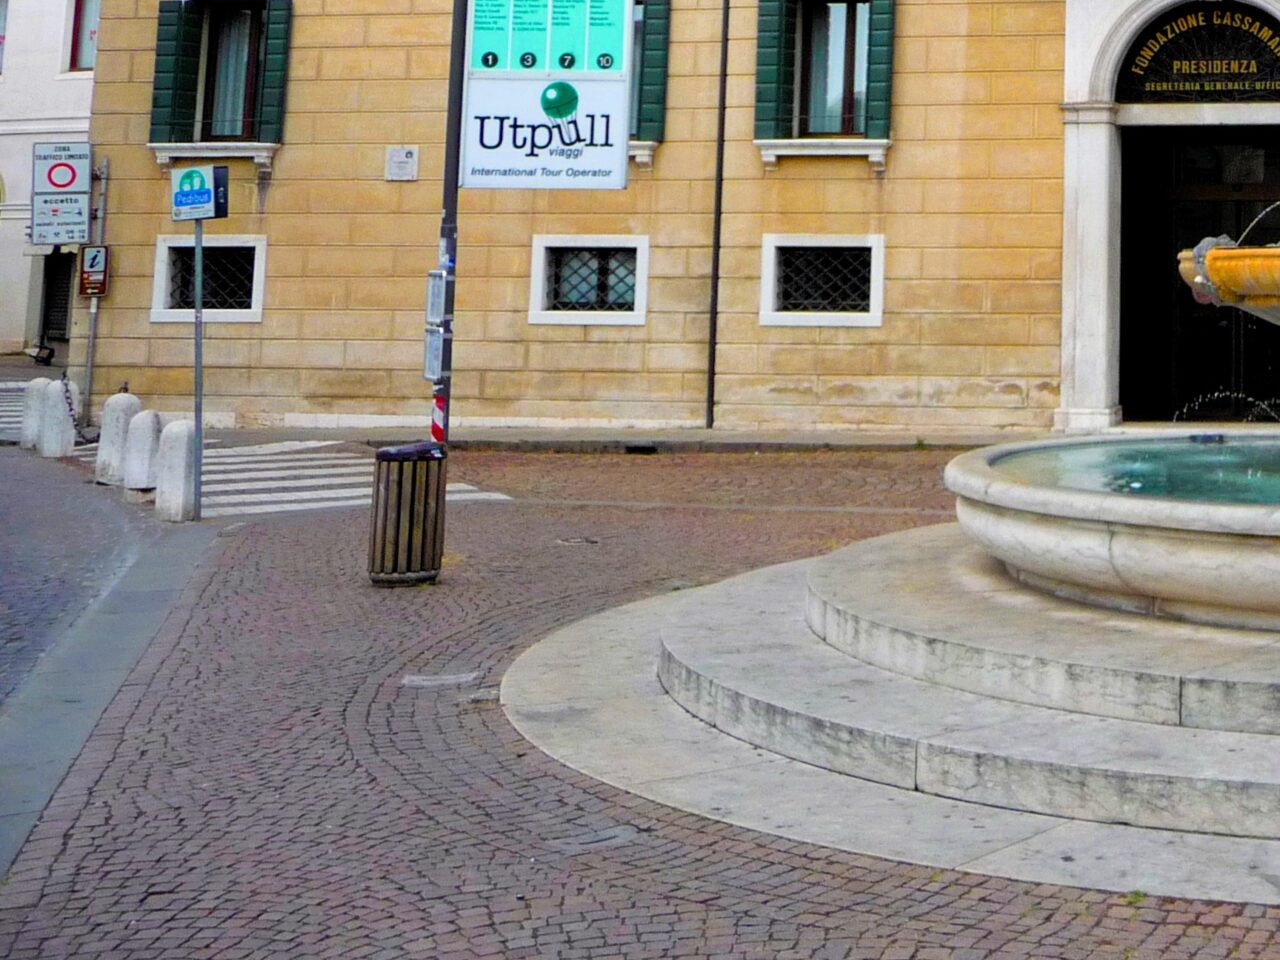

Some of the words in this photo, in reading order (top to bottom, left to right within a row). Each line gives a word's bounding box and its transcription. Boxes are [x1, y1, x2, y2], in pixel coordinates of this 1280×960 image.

[1131, 11, 1205, 75] FONDAZIONE
[486, 54, 494, 65] 1
[523, 54, 533, 66] 3
[563, 55, 572, 66] 7
[599, 56, 612, 67] 10
[1173, 60, 1257, 74] PRESIDENZA
[1144, 82, 1200, 91] SEGRETERIA
[474, 114, 614, 157] Utpull
[549, 146, 584, 159] viaggi
[471, 167, 537, 177] International
[540, 167, 563, 177] Tour
[566, 168, 612, 178] Operator
